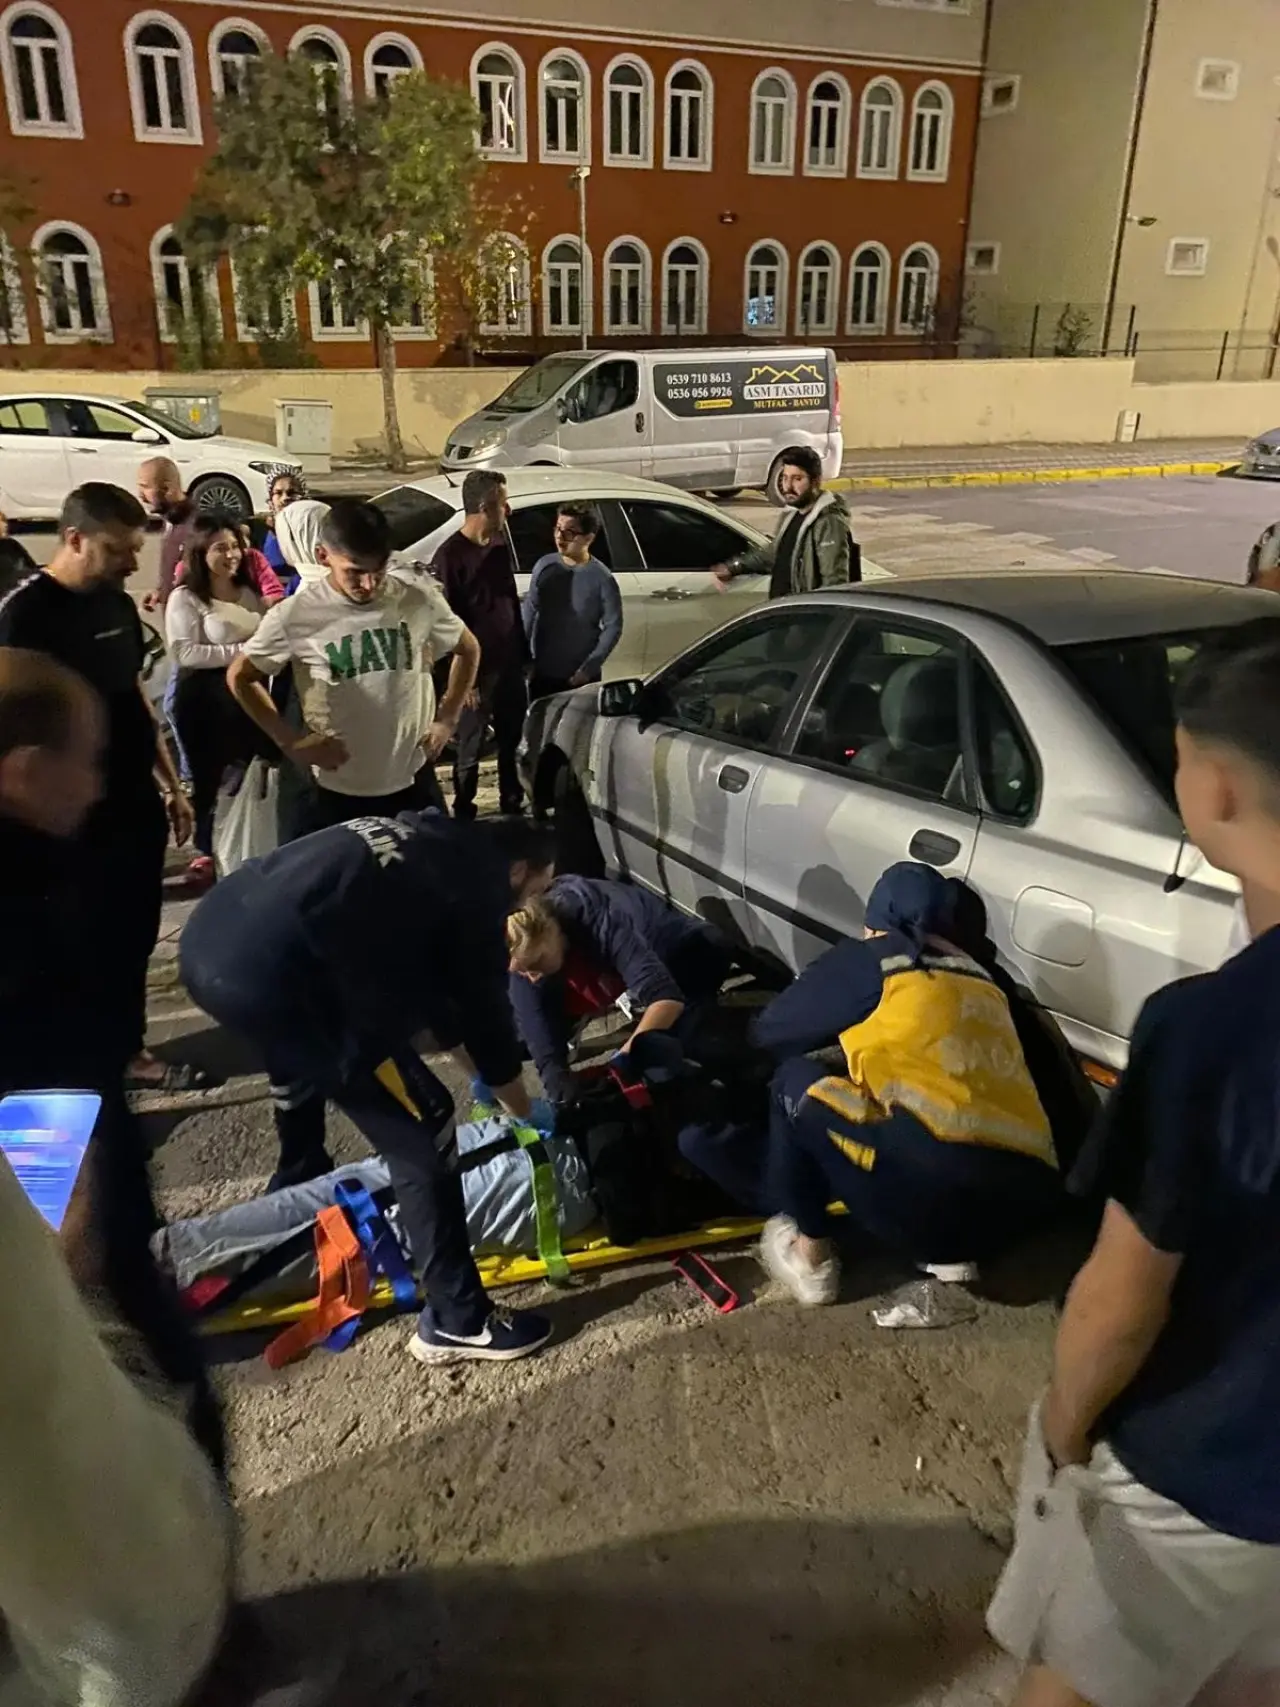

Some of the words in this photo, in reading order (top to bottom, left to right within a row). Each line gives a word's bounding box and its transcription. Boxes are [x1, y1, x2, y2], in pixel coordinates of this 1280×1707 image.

[666, 374, 689, 385] 0539
[691, 373, 708, 384] 710
[709, 372, 732, 383] 8613
[668, 388, 690, 399] 0536
[691, 387, 709, 397] 056
[710, 386, 733, 397] 9926
[745, 386, 771, 398] ASM
[773, 384, 824, 396] TASARIM
[754, 400, 788, 408] MUTFAK
[793, 398, 820, 407] BANYO
